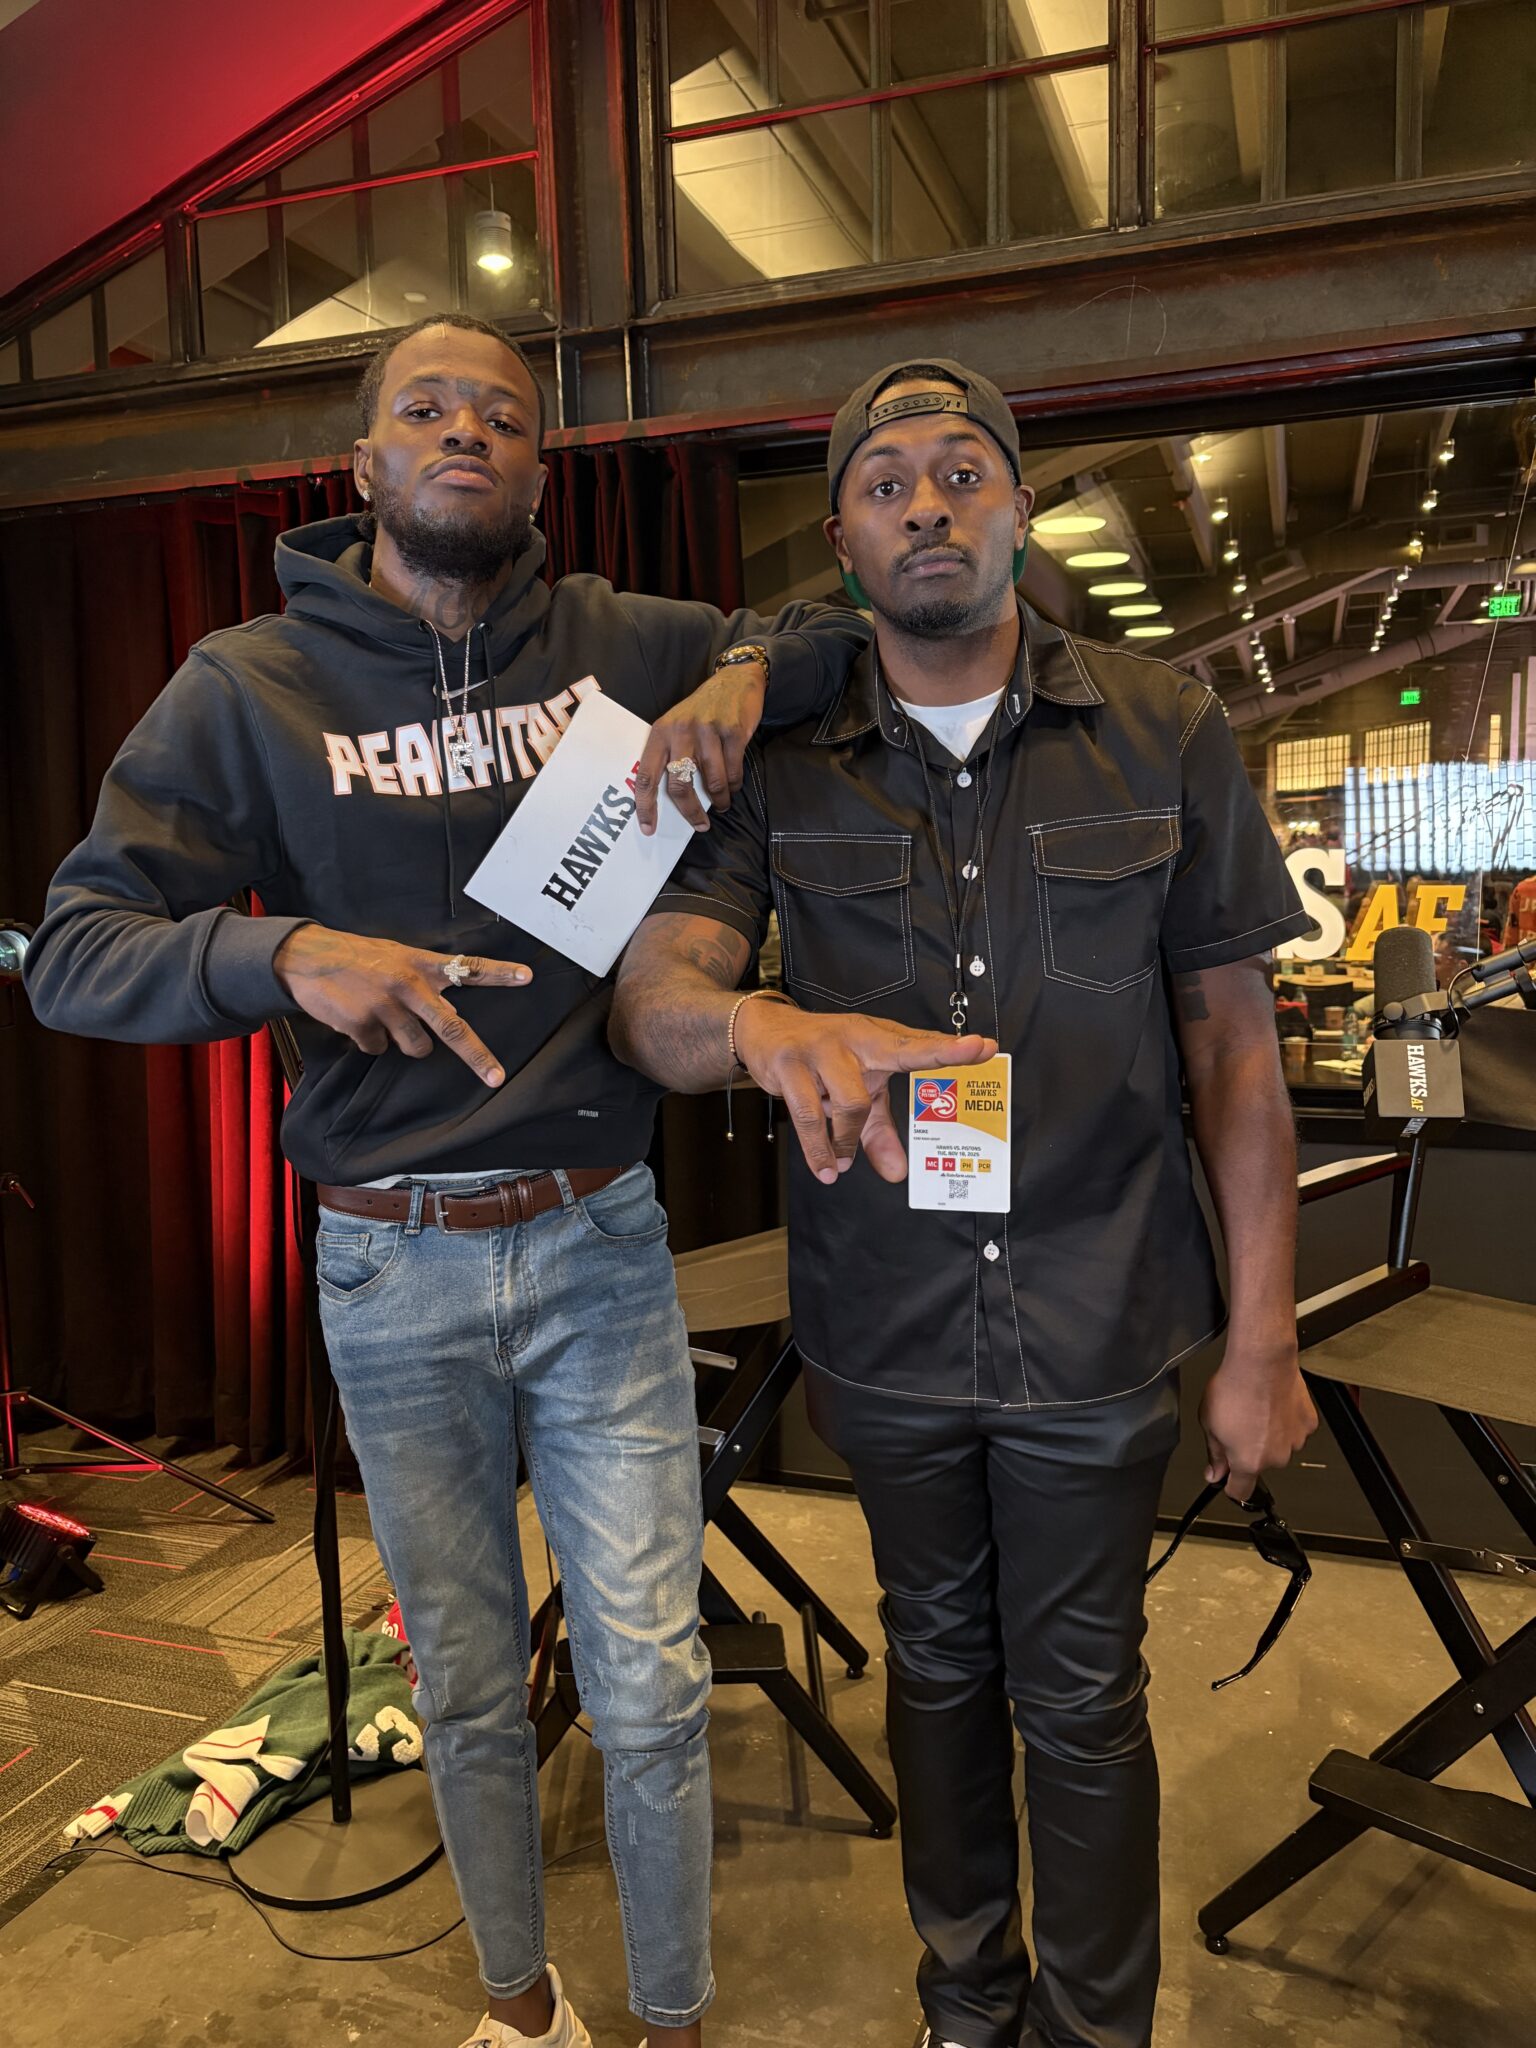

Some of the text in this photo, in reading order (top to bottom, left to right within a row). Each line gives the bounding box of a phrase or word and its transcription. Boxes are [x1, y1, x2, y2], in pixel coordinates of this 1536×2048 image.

[322, 674, 602, 796] PEACHTR
[966, 1081, 1001, 1089] ATLANTA
[970, 1089, 997, 1097] HAWKS
[965, 1100, 1004, 1112] MEDIA
